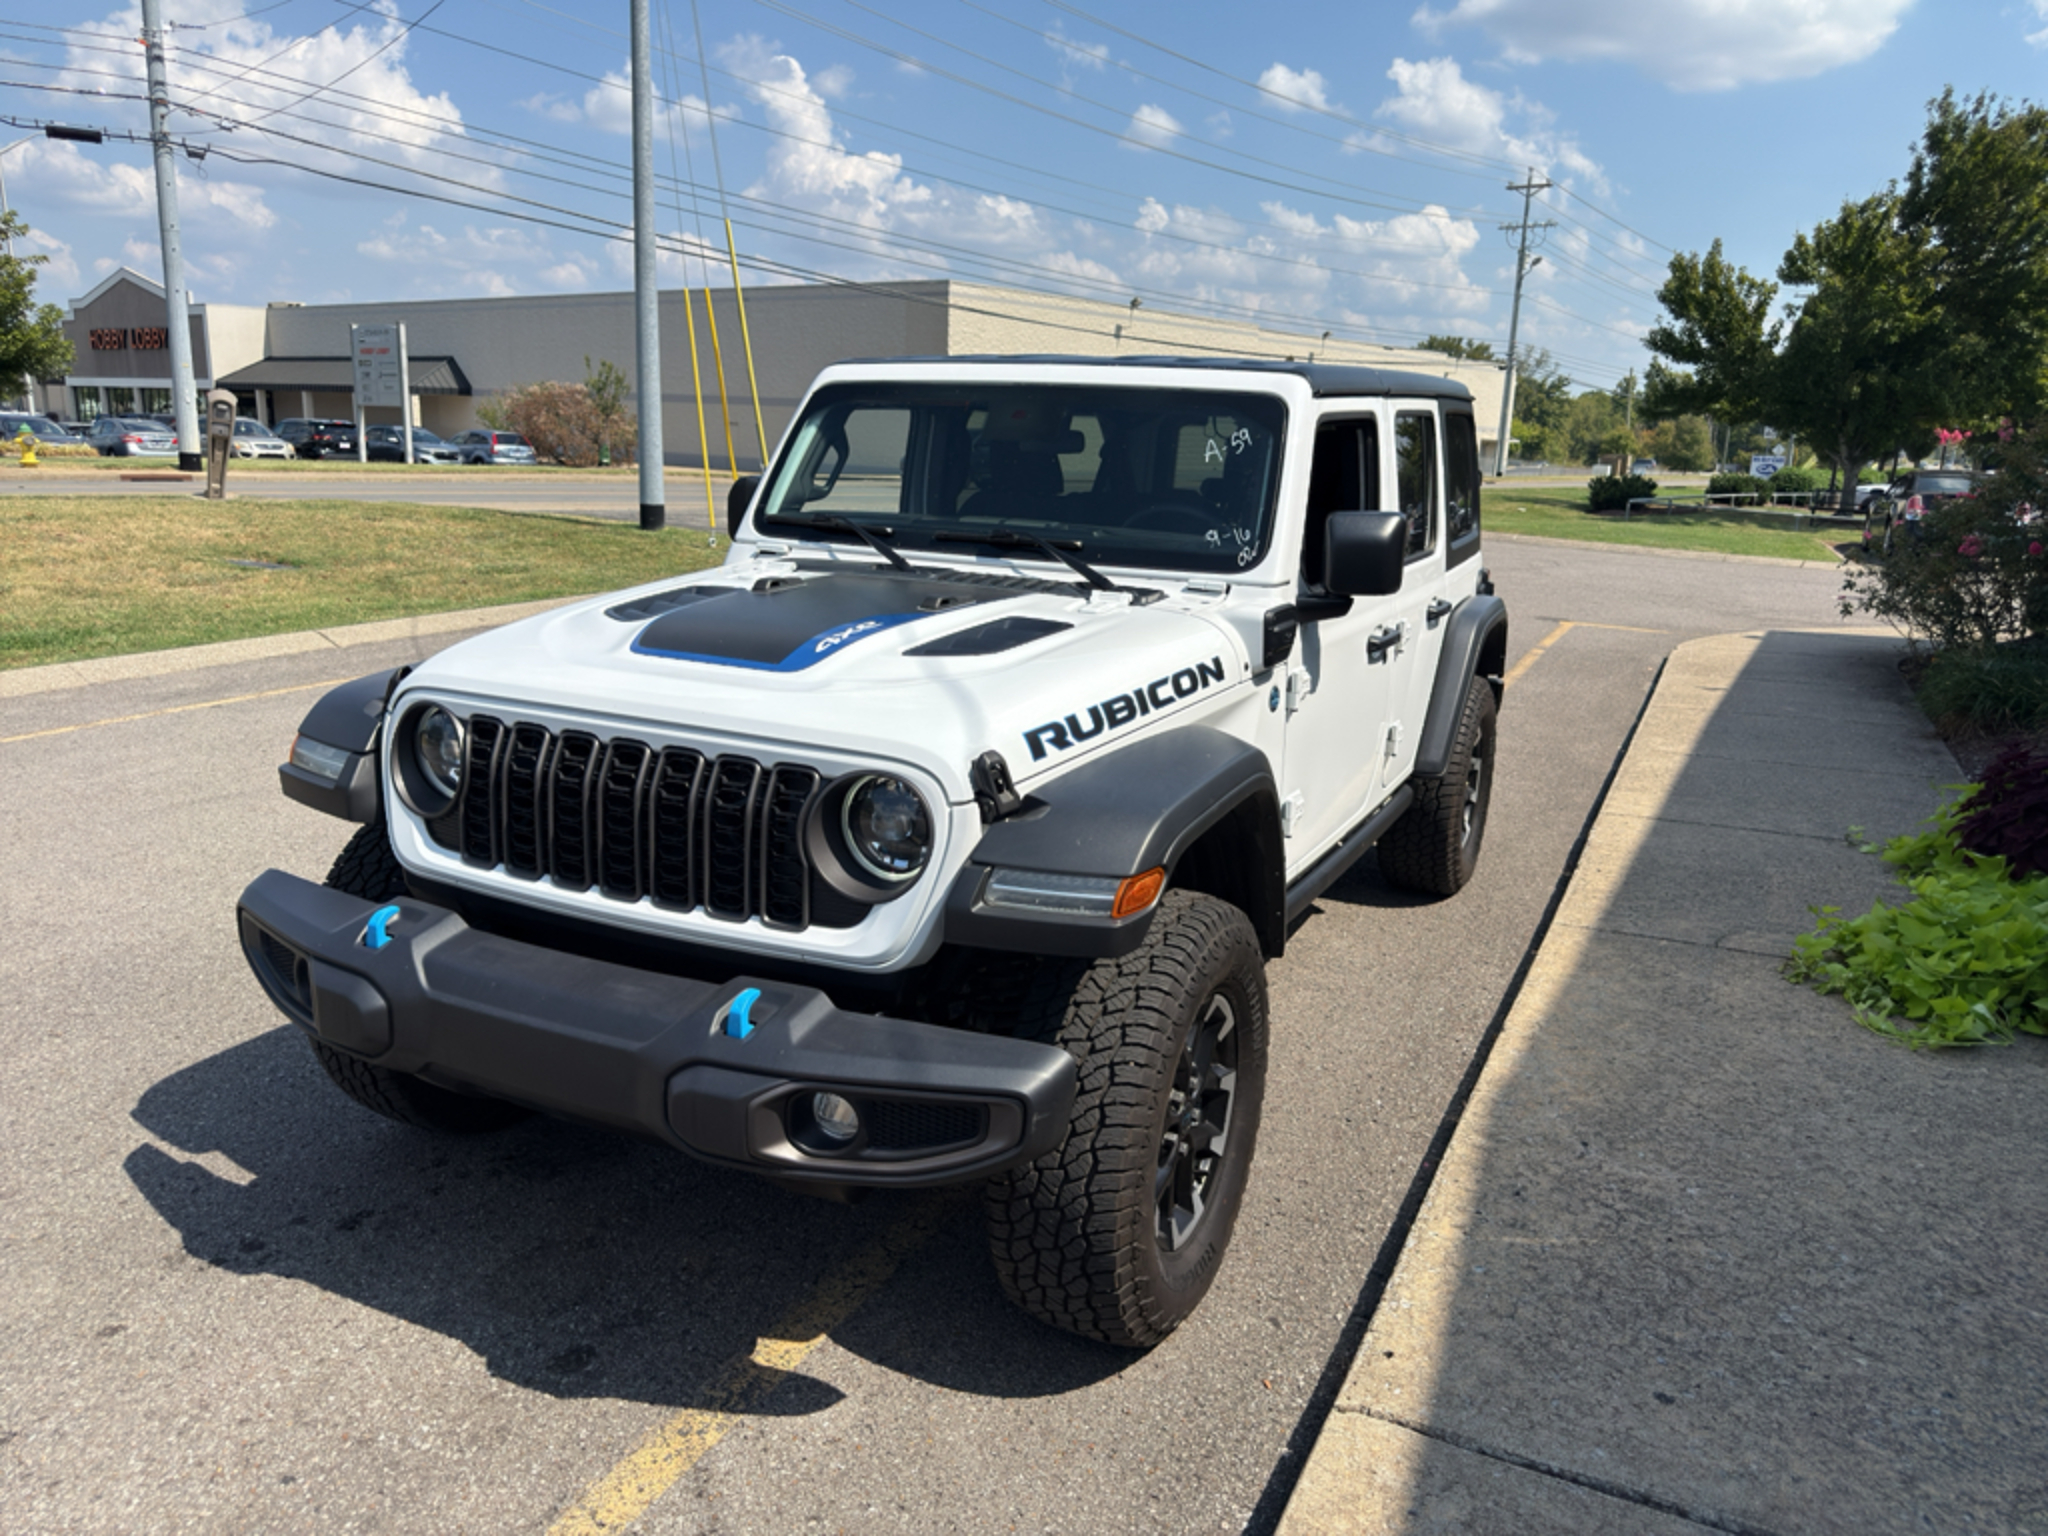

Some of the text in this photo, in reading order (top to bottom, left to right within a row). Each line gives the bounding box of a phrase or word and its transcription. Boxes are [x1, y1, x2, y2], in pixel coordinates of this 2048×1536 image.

[88, 327, 168, 350] HOBBY LOBBY
[1203, 427, 1252, 463] A-59
[1205, 528, 1251, 549] 9-16
[1022, 655, 1225, 762] RUBICON
